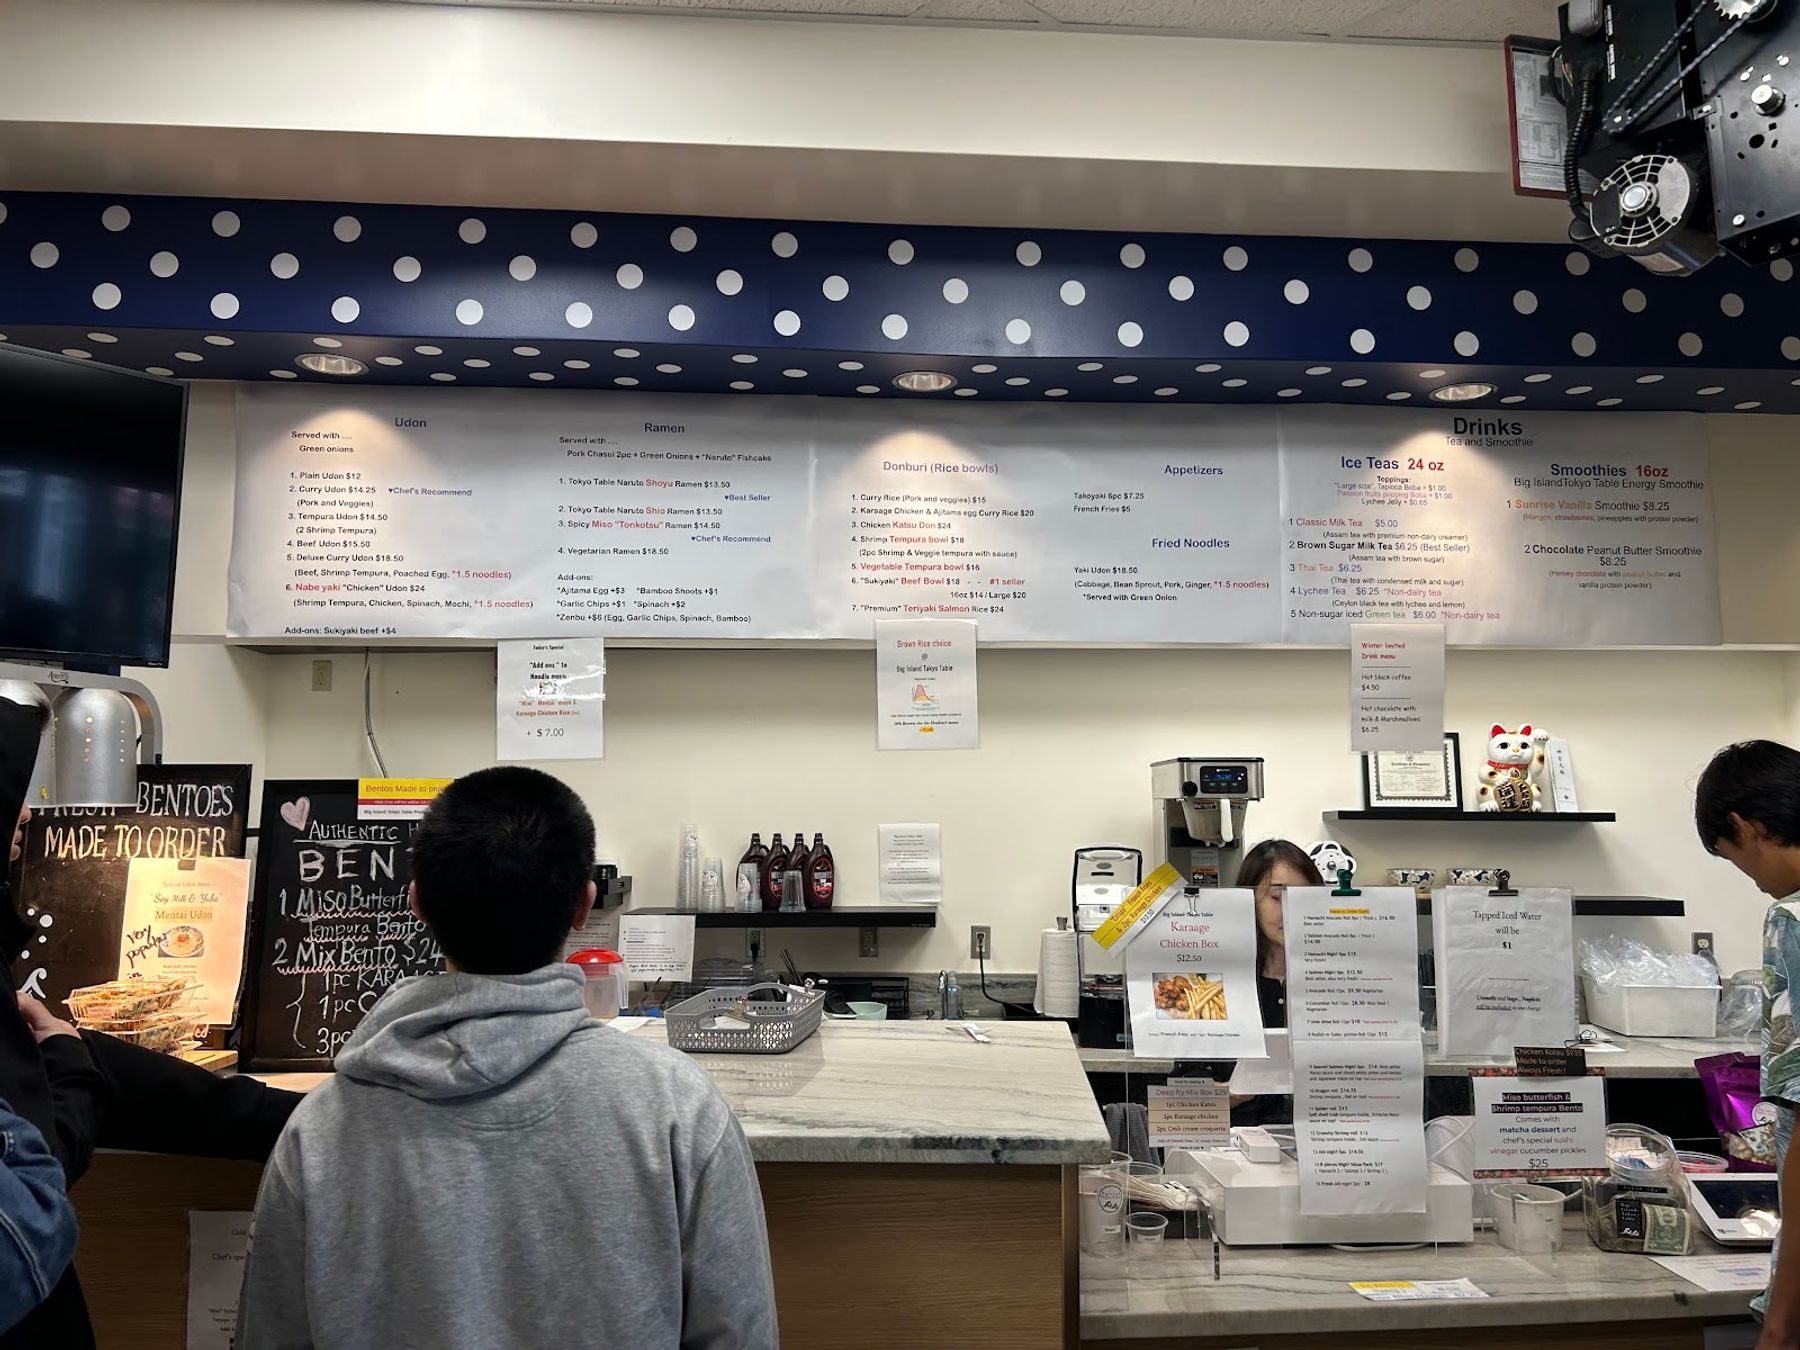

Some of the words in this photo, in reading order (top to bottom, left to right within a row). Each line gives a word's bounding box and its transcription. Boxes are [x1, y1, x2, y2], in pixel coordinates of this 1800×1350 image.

[395, 418, 427, 428] Udon
[1453, 417, 1523, 435] Drinks
[644, 423, 685, 433] Ramen
[1445, 436, 1462, 446] Tea
[1465, 437, 1483, 447] and
[1485, 437, 1534, 447] Smoothie
[300, 445, 324, 453] Green
[327, 445, 354, 453] onions
[883, 462, 927, 472] Donburi
[931, 463, 958, 473] (Rice
[962, 464, 998, 473] bowls)
[1342, 457, 1361, 469] Ice
[1367, 457, 1399, 469] Teas
[1408, 459, 1424, 470] 24
[1429, 461, 1444, 471] oz
[1165, 465, 1223, 475] Appetizers
[1551, 464, 1627, 476] Smoothies
[1636, 465, 1668, 477] 16oz
[300, 472, 319, 480] Plain
[346, 472, 361, 480] $12
[569, 478, 591, 487] Tokyo
[646, 479, 673, 488] Shoyu
[1514, 477, 1530, 488] Big
[1594, 479, 1618, 488] Table
[1623, 480, 1656, 490] Energy
[1660, 480, 1703, 489] Smoothie
[299, 486, 322, 494] Curry
[324, 486, 346, 494] Udon
[348, 486, 376, 494] $14.25
[421, 488, 472, 496] Recommend
[339, 500, 373, 508] Veggies)
[1515, 500, 1555, 509] Sunrise
[1559, 501, 1592, 509] Vanilla
[1595, 501, 1640, 510] Smoothie
[1643, 502, 1669, 510] $8.25
[1375, 519, 1398, 527] $5.00
[861, 536, 887, 544] Shrimp
[889, 536, 926, 544] Tempura
[1152, 539, 1180, 548] Fried
[1184, 539, 1230, 548] Noodles
[1297, 541, 1326, 549] Brown
[1329, 542, 1355, 551] Sugar
[1357, 542, 1376, 550] Milk
[1395, 543, 1418, 551] $6.25
[1420, 544, 1441, 552] (Best
[1444, 544, 1470, 552] Seller)
[586, 600, 610, 609] Chips
[904, 605, 936, 613] Teriyaki
[938, 605, 969, 613] Salmon
[285, 627, 322, 635] Add-ons:
[324, 627, 358, 636] Sukiyaki
[360, 627, 378, 635] beef
[897, 640, 916, 648] Brown
[138, 782, 233, 817] BENTOES
[45, 826, 107, 859] MADE
[114, 825, 141, 858] TO
[147, 826, 226, 858] ORDER
[299, 847, 414, 881] BEN
[155, 910, 186, 920] Mentai
[190, 910, 212, 919] Udon
[1473, 911, 1500, 921] Tapped
[1502, 912, 1517, 920] Iced
[1171, 922, 1210, 933] Karaage
[1160, 940, 1198, 948] Chicken
[1202, 940, 1218, 948] Box
[272, 940, 287, 965] 2
[296, 942, 334, 966] Mix
[341, 942, 395, 966] Bento
[1177, 954, 1202, 962] $12.50
[1502, 1093, 1521, 1101] Miso
[1523, 1093, 1563, 1101] butterfish
[1491, 1104, 1521, 1113] Shrimp
[1523, 1104, 1557, 1113] tempura
[1559, 1104, 1583, 1112] Bento
[1503, 1136, 1525, 1144] chef's
[1527, 1136, 1552, 1144] special
[1490, 1147, 1518, 1155] vinegar
[1529, 1159, 1548, 1168] $25
